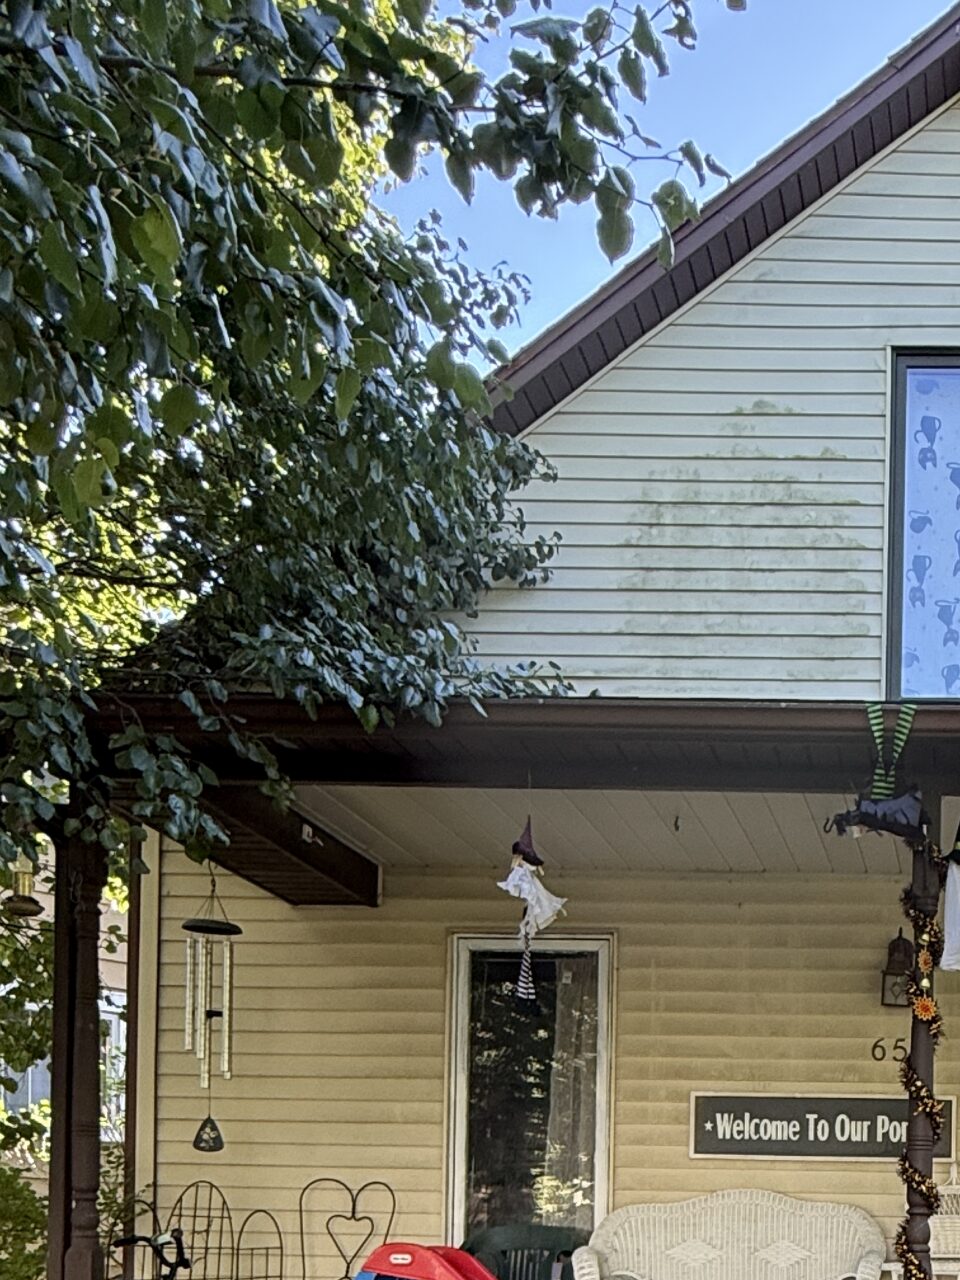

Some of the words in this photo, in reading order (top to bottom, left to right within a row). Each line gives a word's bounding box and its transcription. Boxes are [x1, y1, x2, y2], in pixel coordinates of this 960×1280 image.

[871, 1037, 908, 1062] 65
[715, 1112, 800, 1140] Welcome
[804, 1113, 830, 1142] To
[835, 1114, 871, 1142] Our
[876, 1115, 909, 1142] Por
